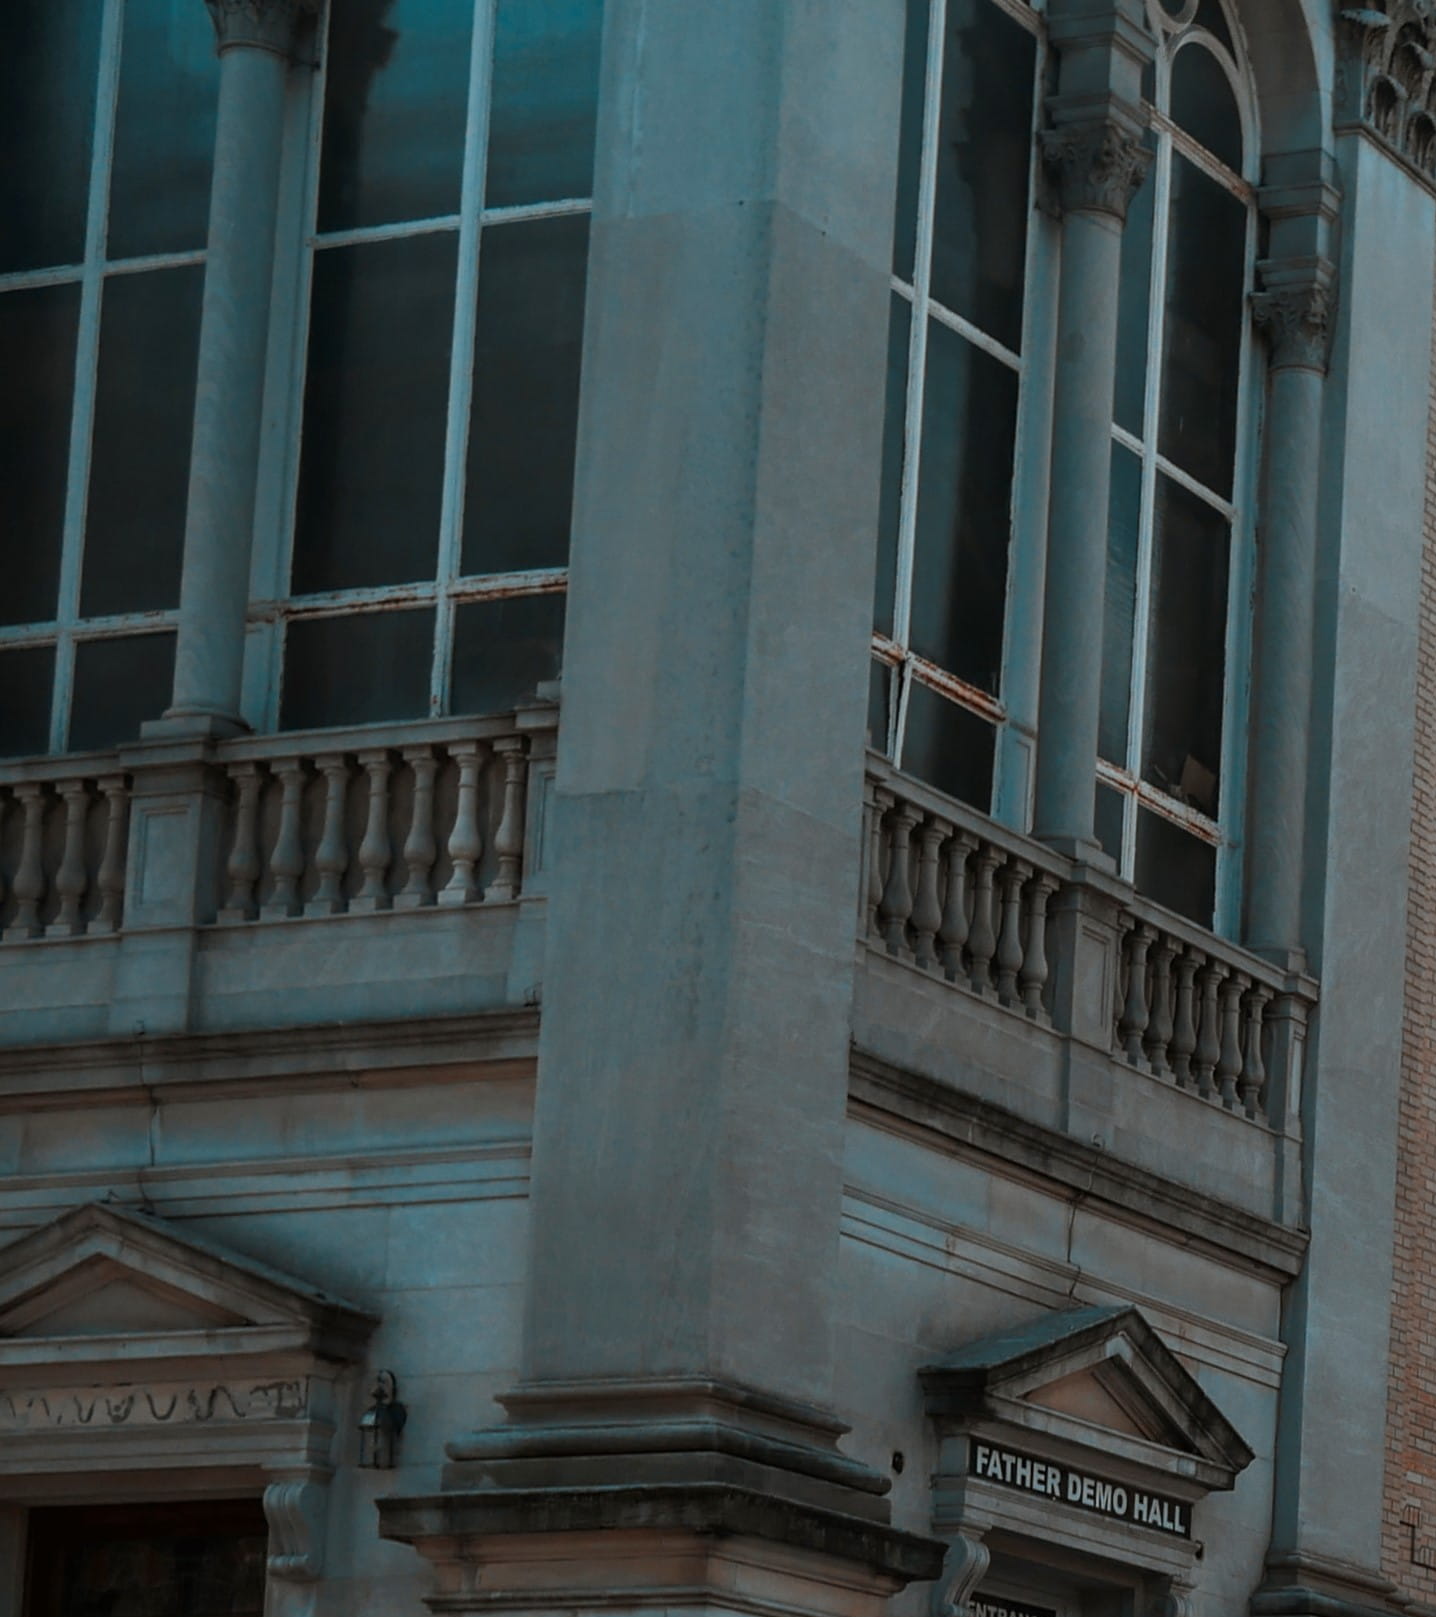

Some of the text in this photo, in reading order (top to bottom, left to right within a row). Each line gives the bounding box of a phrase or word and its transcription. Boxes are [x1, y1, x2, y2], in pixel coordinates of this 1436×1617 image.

[976, 1445, 1186, 1534] FATHER DEMO HALL
